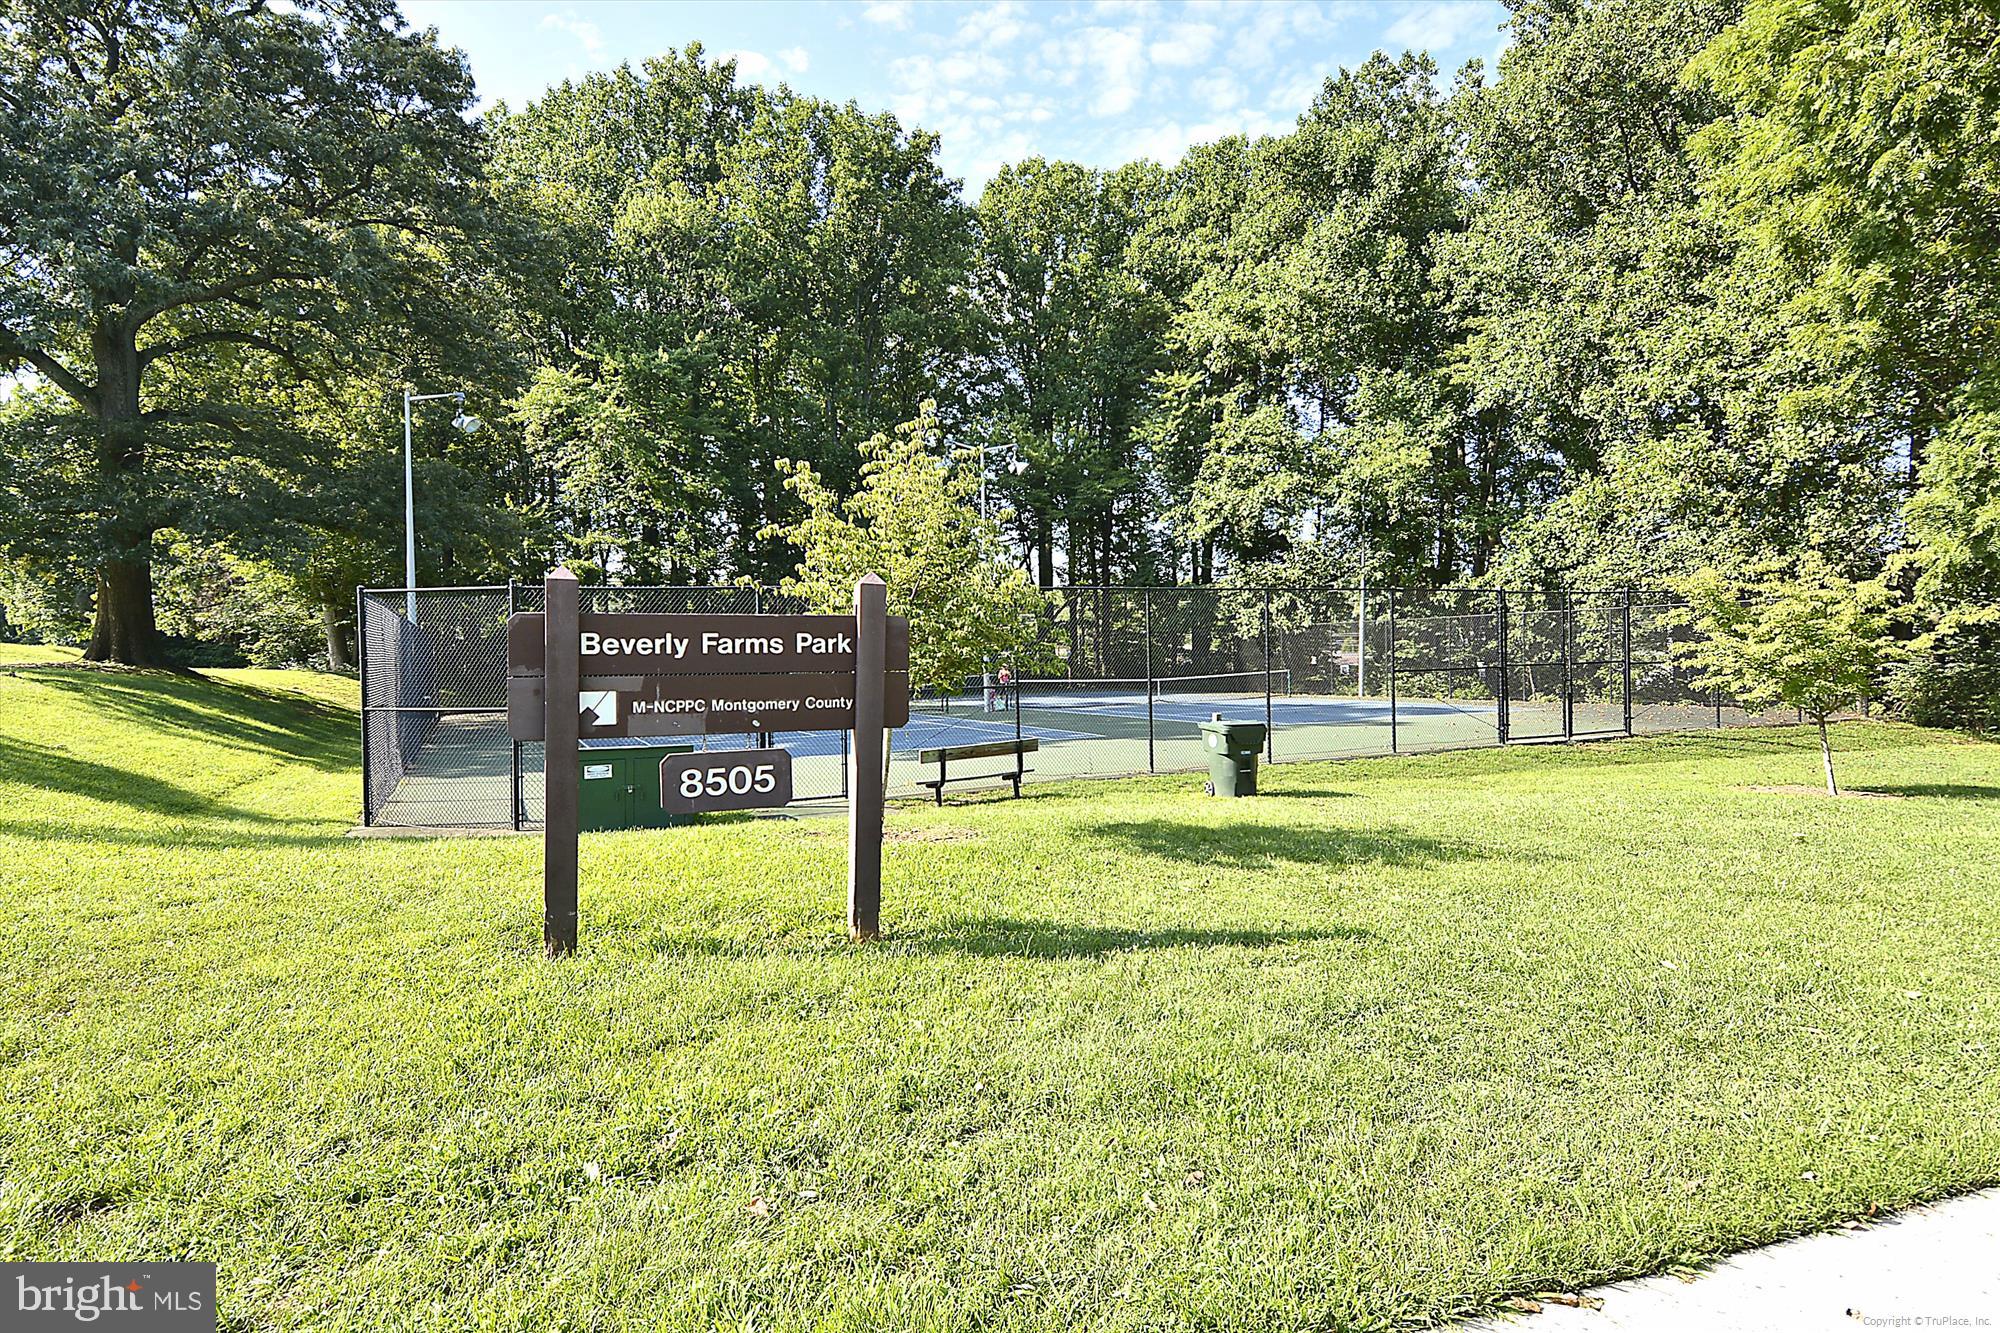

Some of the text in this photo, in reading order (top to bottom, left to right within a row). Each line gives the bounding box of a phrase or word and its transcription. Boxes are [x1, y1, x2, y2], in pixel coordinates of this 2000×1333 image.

[580, 632, 852, 659] Beverly Farms Park
[632, 696, 854, 714] M-NCPPC Montgomery County
[679, 765, 776, 799] 8505
